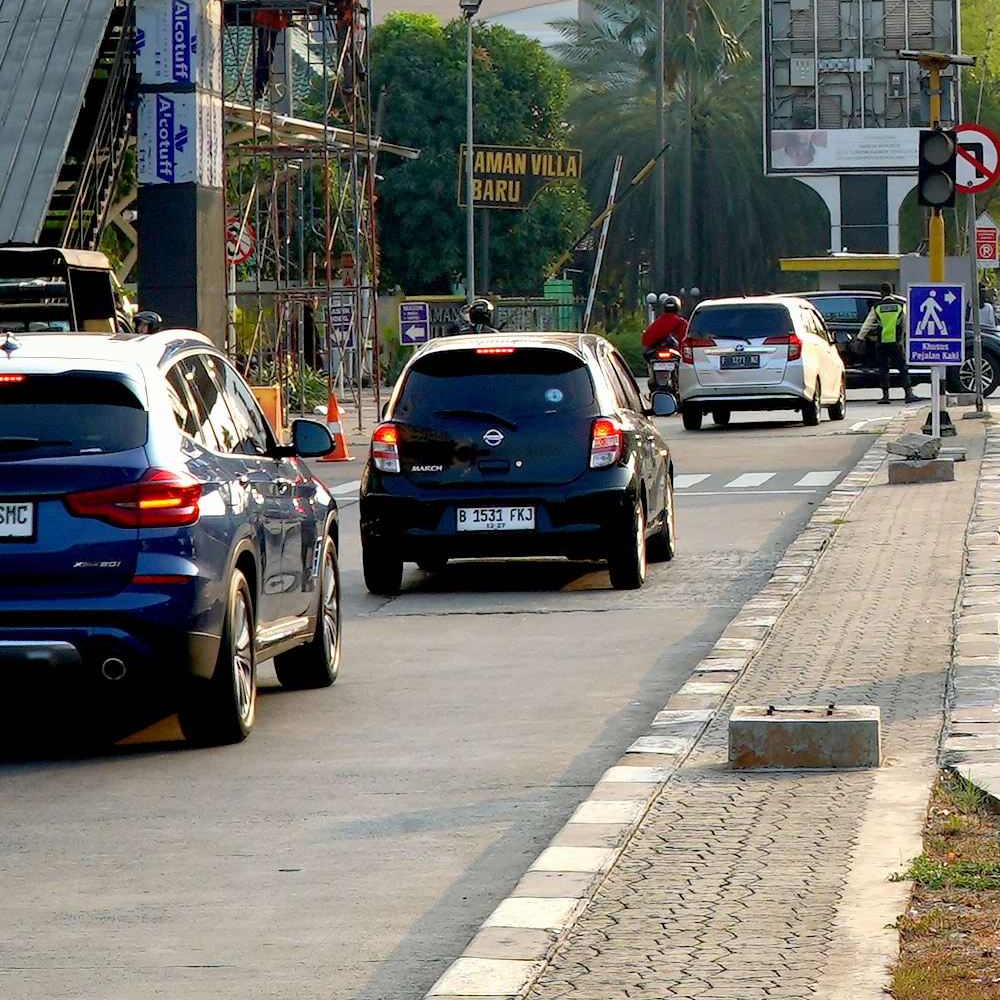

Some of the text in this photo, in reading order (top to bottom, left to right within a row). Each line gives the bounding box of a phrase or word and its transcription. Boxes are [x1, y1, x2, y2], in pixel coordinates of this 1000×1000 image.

[174, 1, 188, 79] Alcotuff
[462, 150, 577, 178] AMAN VILLA
[473, 179, 520, 203] BARU
[942, 351, 960, 360] Kaki
[459, 508, 534, 523] B 1531 FKJ
